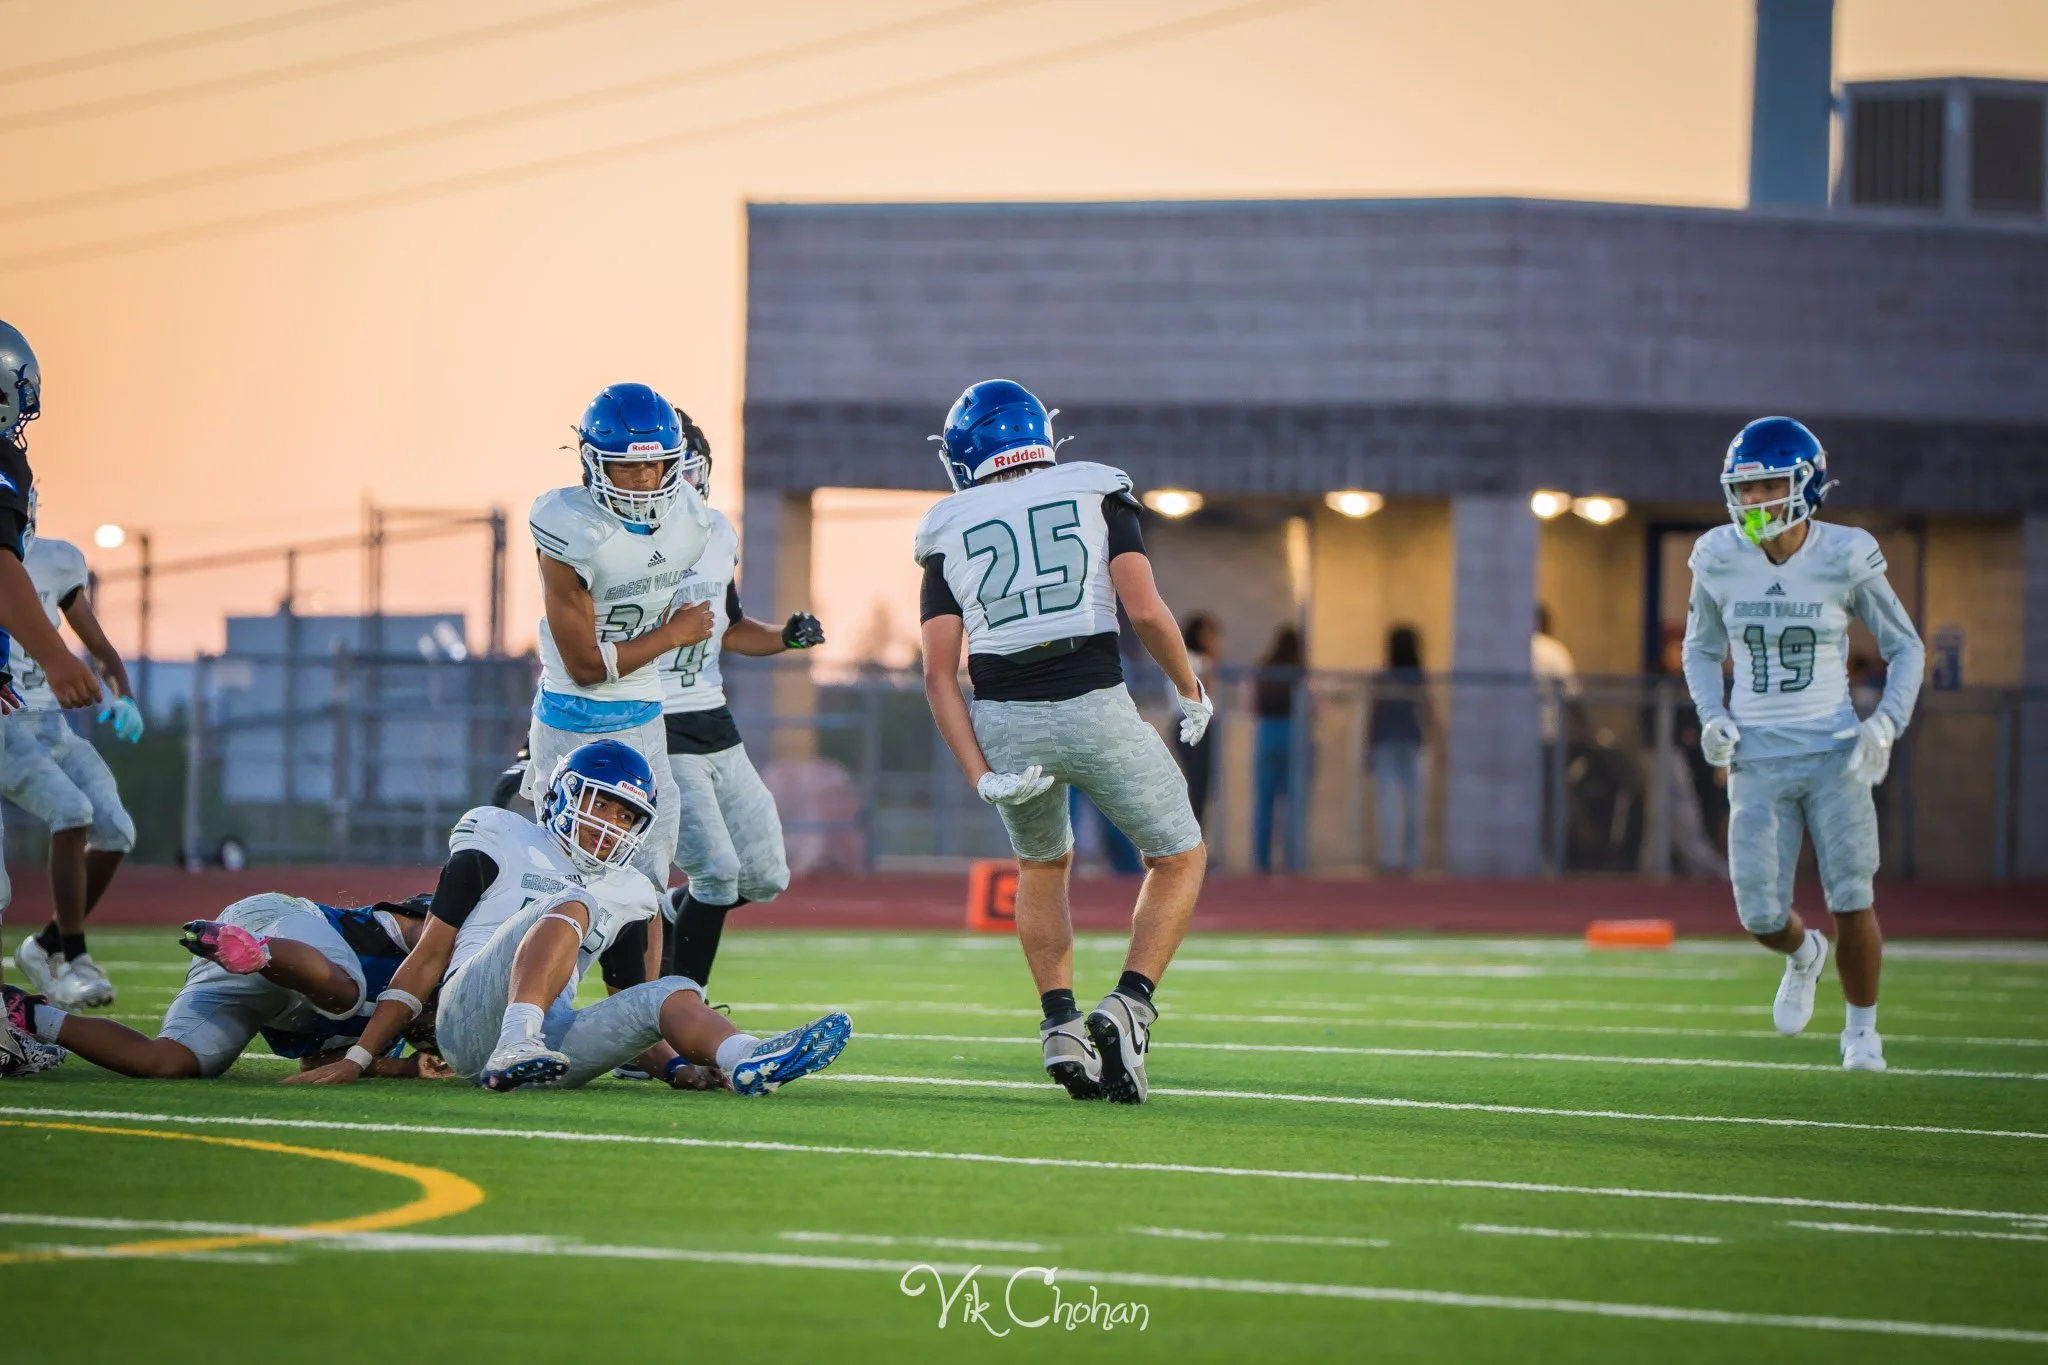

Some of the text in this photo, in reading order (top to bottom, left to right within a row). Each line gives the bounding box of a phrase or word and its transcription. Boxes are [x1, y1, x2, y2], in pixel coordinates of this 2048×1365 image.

[632, 444, 660, 452] Riddell
[994, 447, 1045, 467] Riddell
[962, 499, 1089, 630] 25
[604, 577, 652, 601] GREEN
[1774, 602, 1823, 618] VALLEY
[1743, 624, 1817, 693] 19
[621, 782, 646, 799] Riddell
